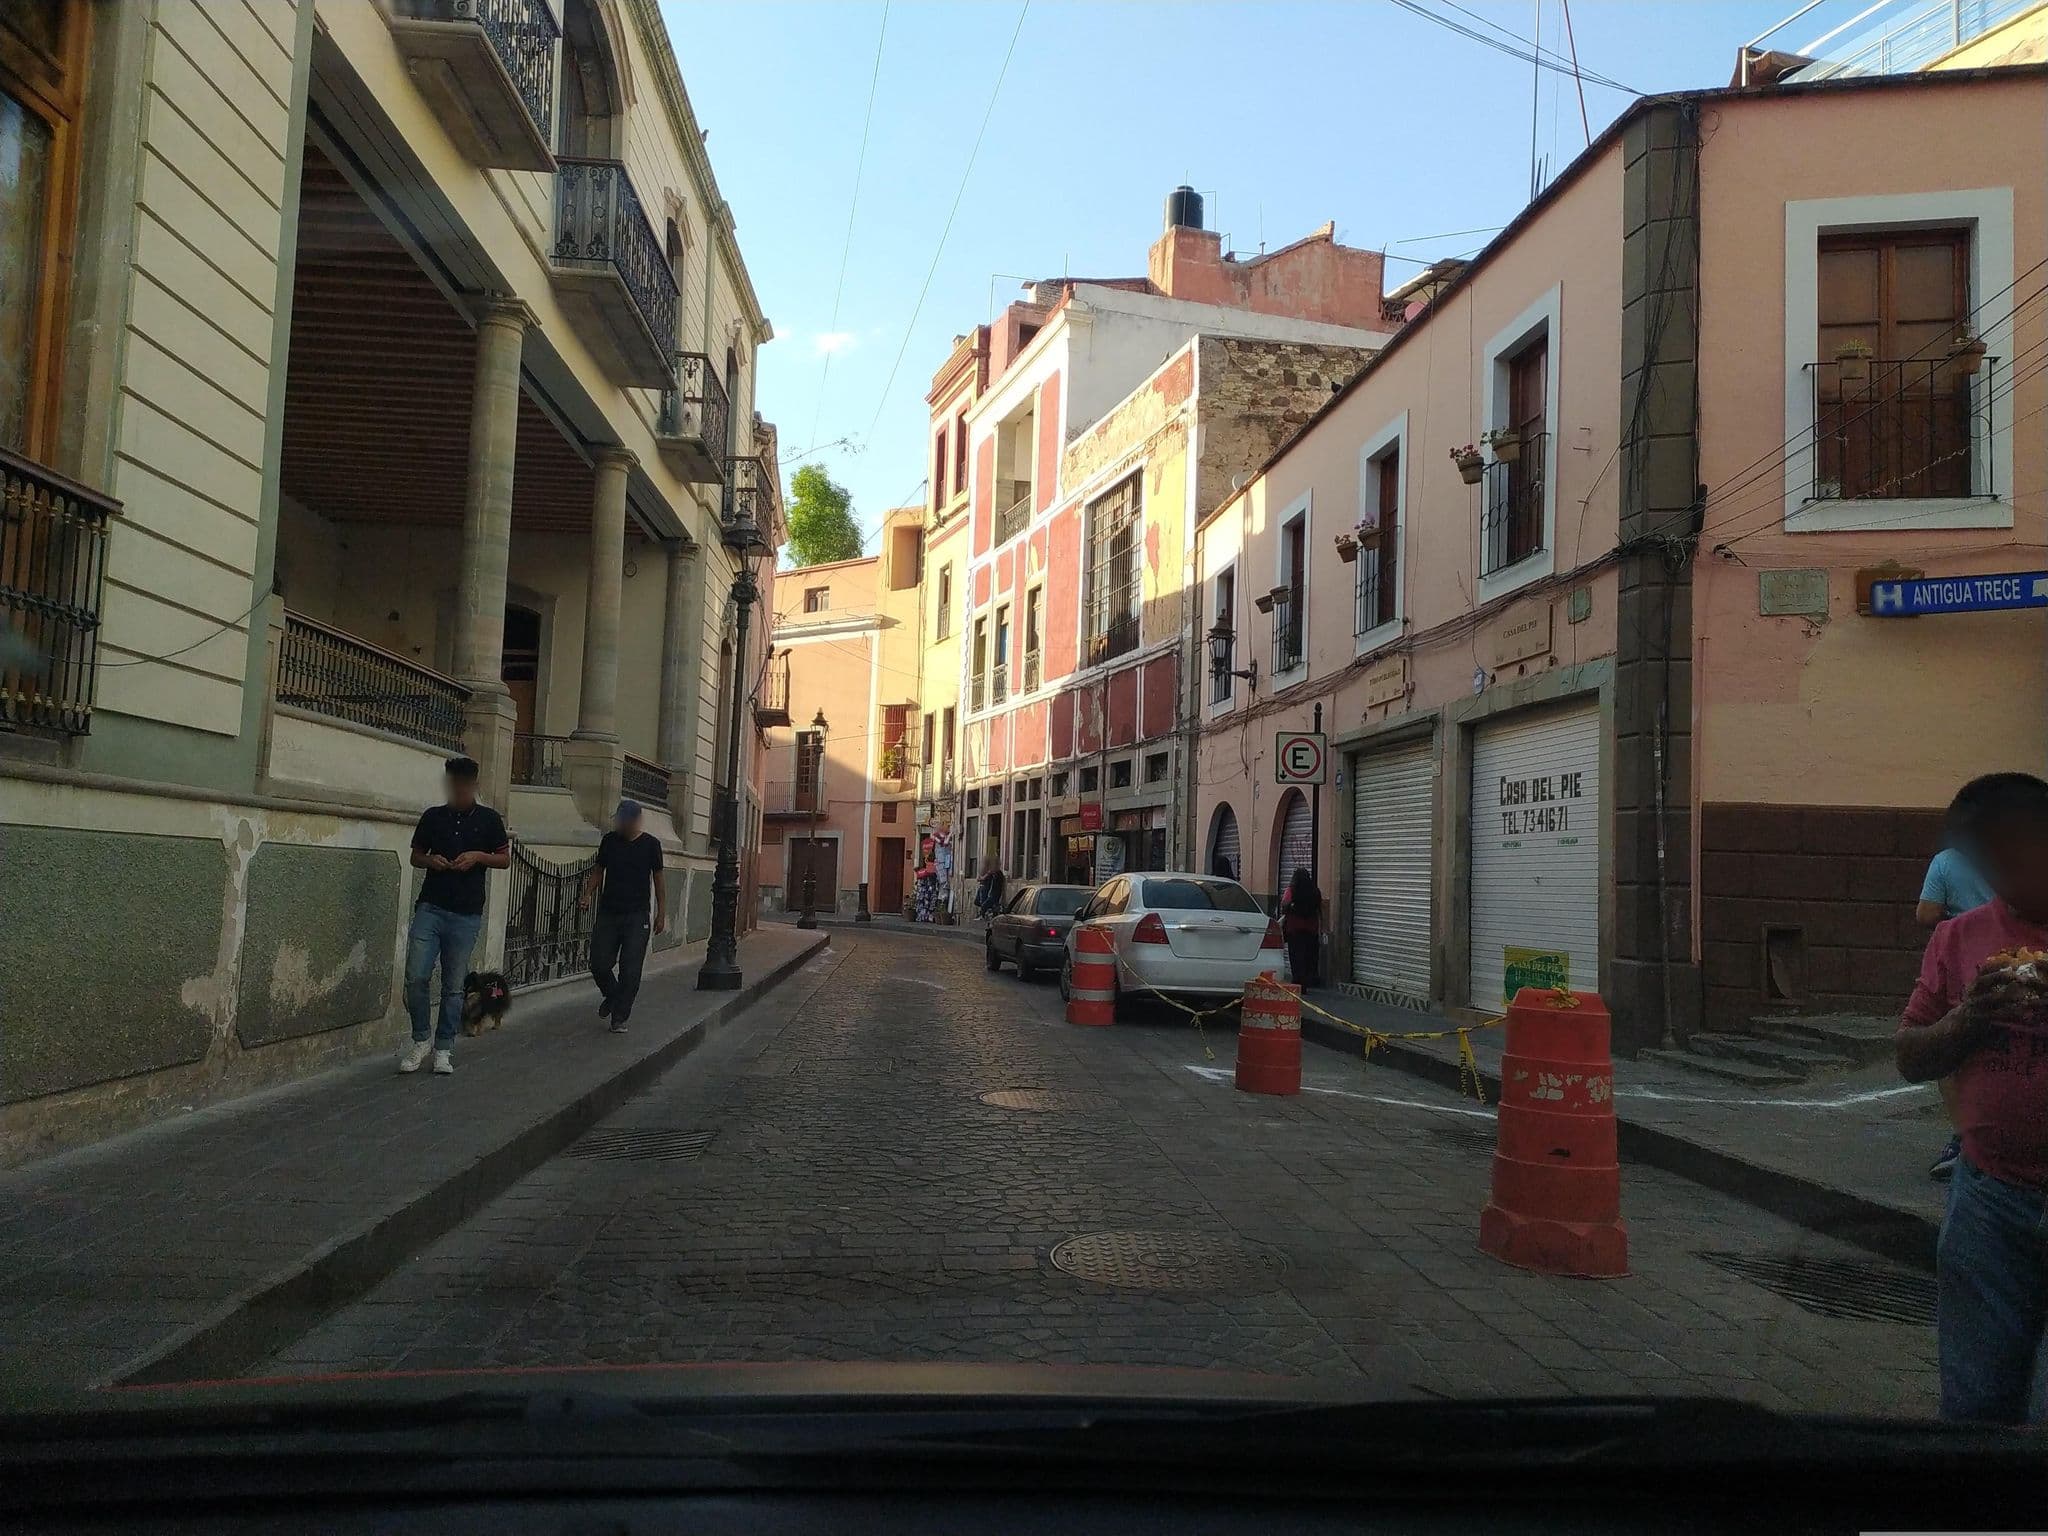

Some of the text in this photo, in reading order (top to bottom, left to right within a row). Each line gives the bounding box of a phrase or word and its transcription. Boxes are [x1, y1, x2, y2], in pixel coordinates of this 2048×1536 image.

[1913, 582, 1973, 606] ANTIGUA
[1974, 578, 2021, 602] TRECE
[1292, 746, 1310, 770] E
[1532, 776, 1555, 803] DEL
[1561, 772, 1582, 800] PIE
